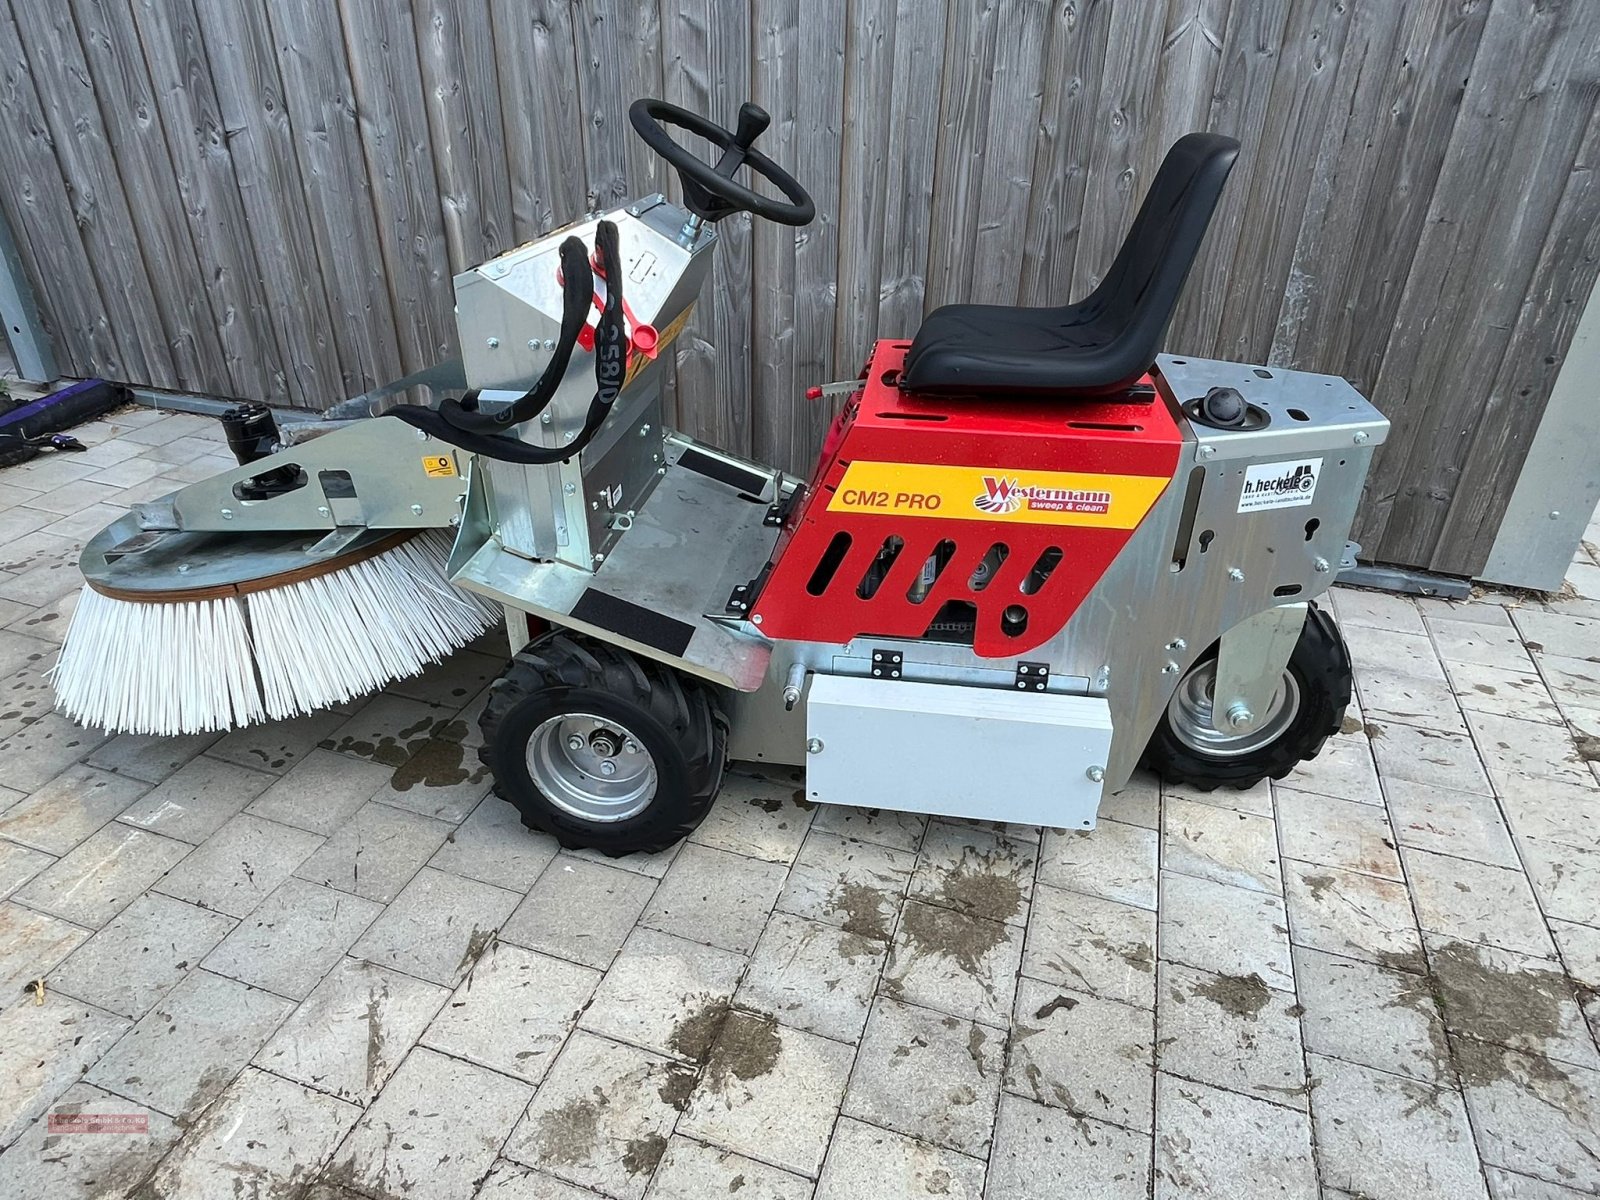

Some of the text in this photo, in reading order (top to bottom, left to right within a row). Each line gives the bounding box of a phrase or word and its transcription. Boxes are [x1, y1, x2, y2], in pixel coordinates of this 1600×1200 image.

[842, 489, 941, 510] CM2 PRO
[984, 477, 1110, 502] Westermann
[1031, 500, 1106, 513] sweep & clean.
